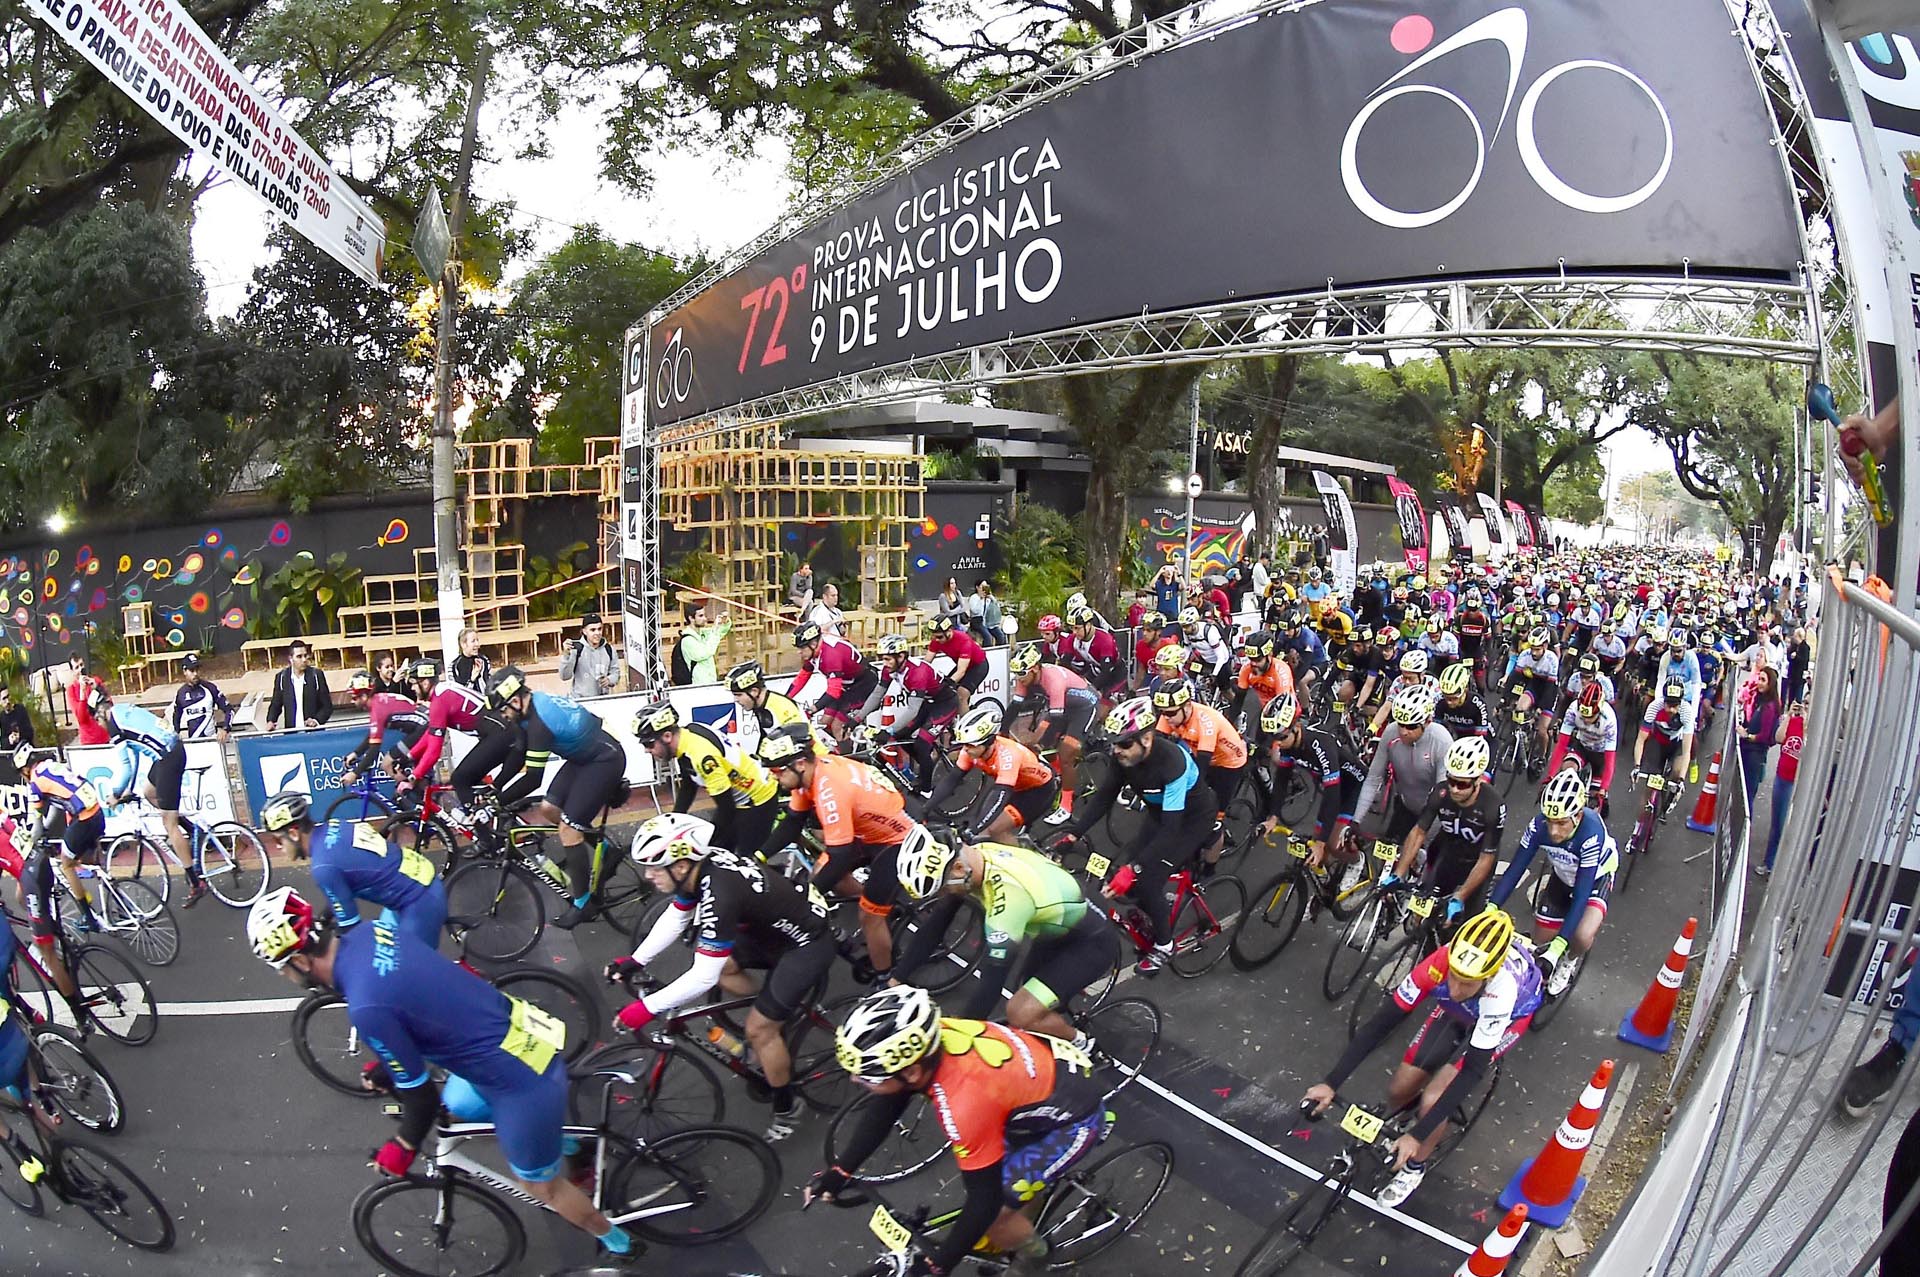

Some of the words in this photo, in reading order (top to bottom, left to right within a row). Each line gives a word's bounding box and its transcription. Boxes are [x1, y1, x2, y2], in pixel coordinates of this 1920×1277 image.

[65, 4, 83, 31] O
[79, 16, 148, 93] PARQUE
[145, 78, 171, 113] DO
[170, 99, 212, 149] POVO
[211, 135, 225, 160] E
[225, 145, 260, 191] VILLA
[261, 179, 300, 221] LOBOS
[92, 0, 139, 43] AIXA
[137, 29, 224, 126] DESATIVADA
[225, 112, 251, 149] DAS
[251, 138, 286, 180] 07h00
[285, 165, 301, 194] ÀS
[302, 184, 331, 220] 12h00
[171, 22, 271, 139] INTERNACIONAL
[272, 126, 282, 146] 9
[281, 134, 298, 162] DE
[297, 152, 331, 193] JULHO
[812, 215, 886, 274] PROVA
[894, 136, 1063, 234] CICLÍSTICA
[810, 181, 1063, 311] INTERNACIONAL
[809, 315, 828, 364] 9
[837, 297, 880, 354] DE
[896, 237, 1064, 340] JULHO
[977, 720, 991, 734] 93
[1311, 739, 1331, 776] Deluka
[1546, 804, 1559, 816] 79
[924, 845, 945, 876] 404
[1376, 844, 1393, 857] 326
[1457, 949, 1480, 967] 47
[885, 1032, 922, 1066] 369
[1353, 1114, 1372, 1130] 47
